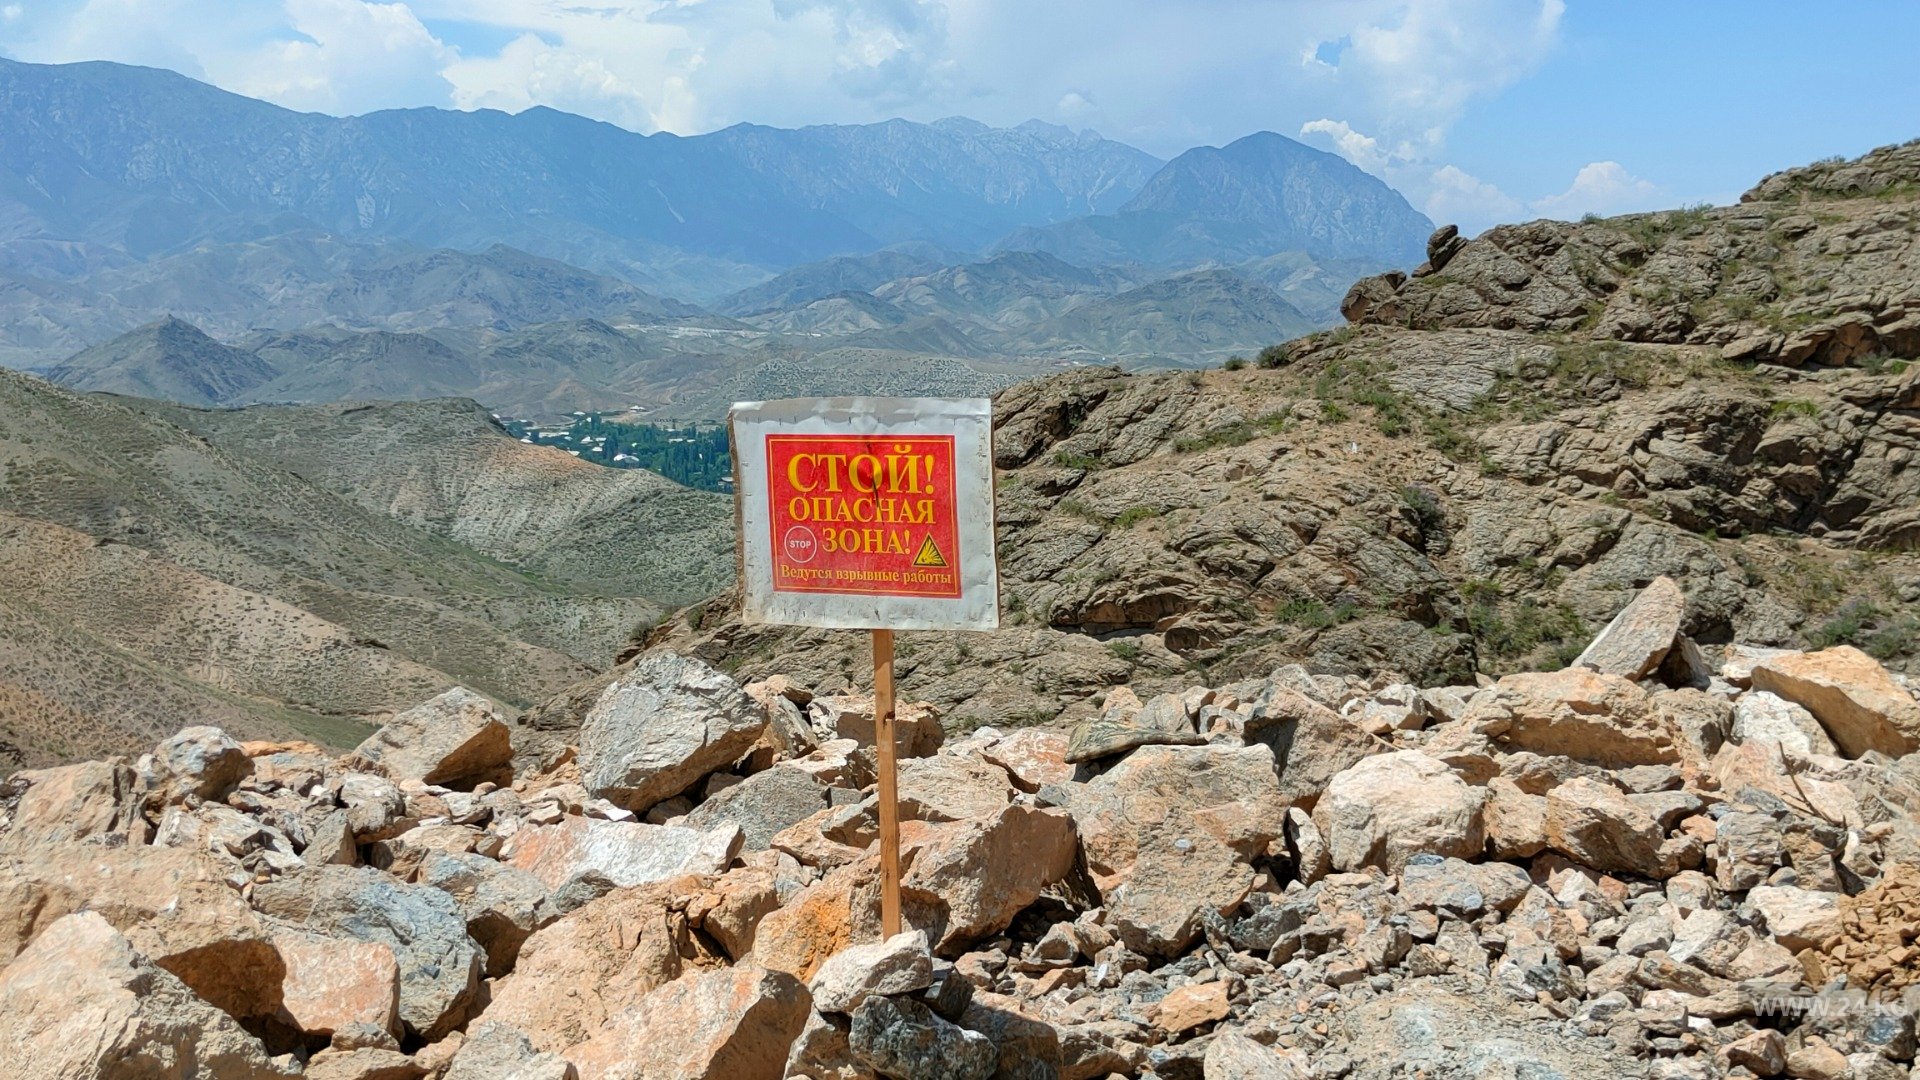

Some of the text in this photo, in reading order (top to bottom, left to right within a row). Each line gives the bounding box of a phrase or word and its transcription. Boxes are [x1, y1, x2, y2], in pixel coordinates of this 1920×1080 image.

[787, 445, 934, 494] СТОЙ!
[789, 497, 936, 524] ОПАСНАЯ
[789, 540, 811, 548] STOP
[822, 529, 911, 554] ЗОНА!
[781, 565, 951, 584] Ведутся взрывные работы
